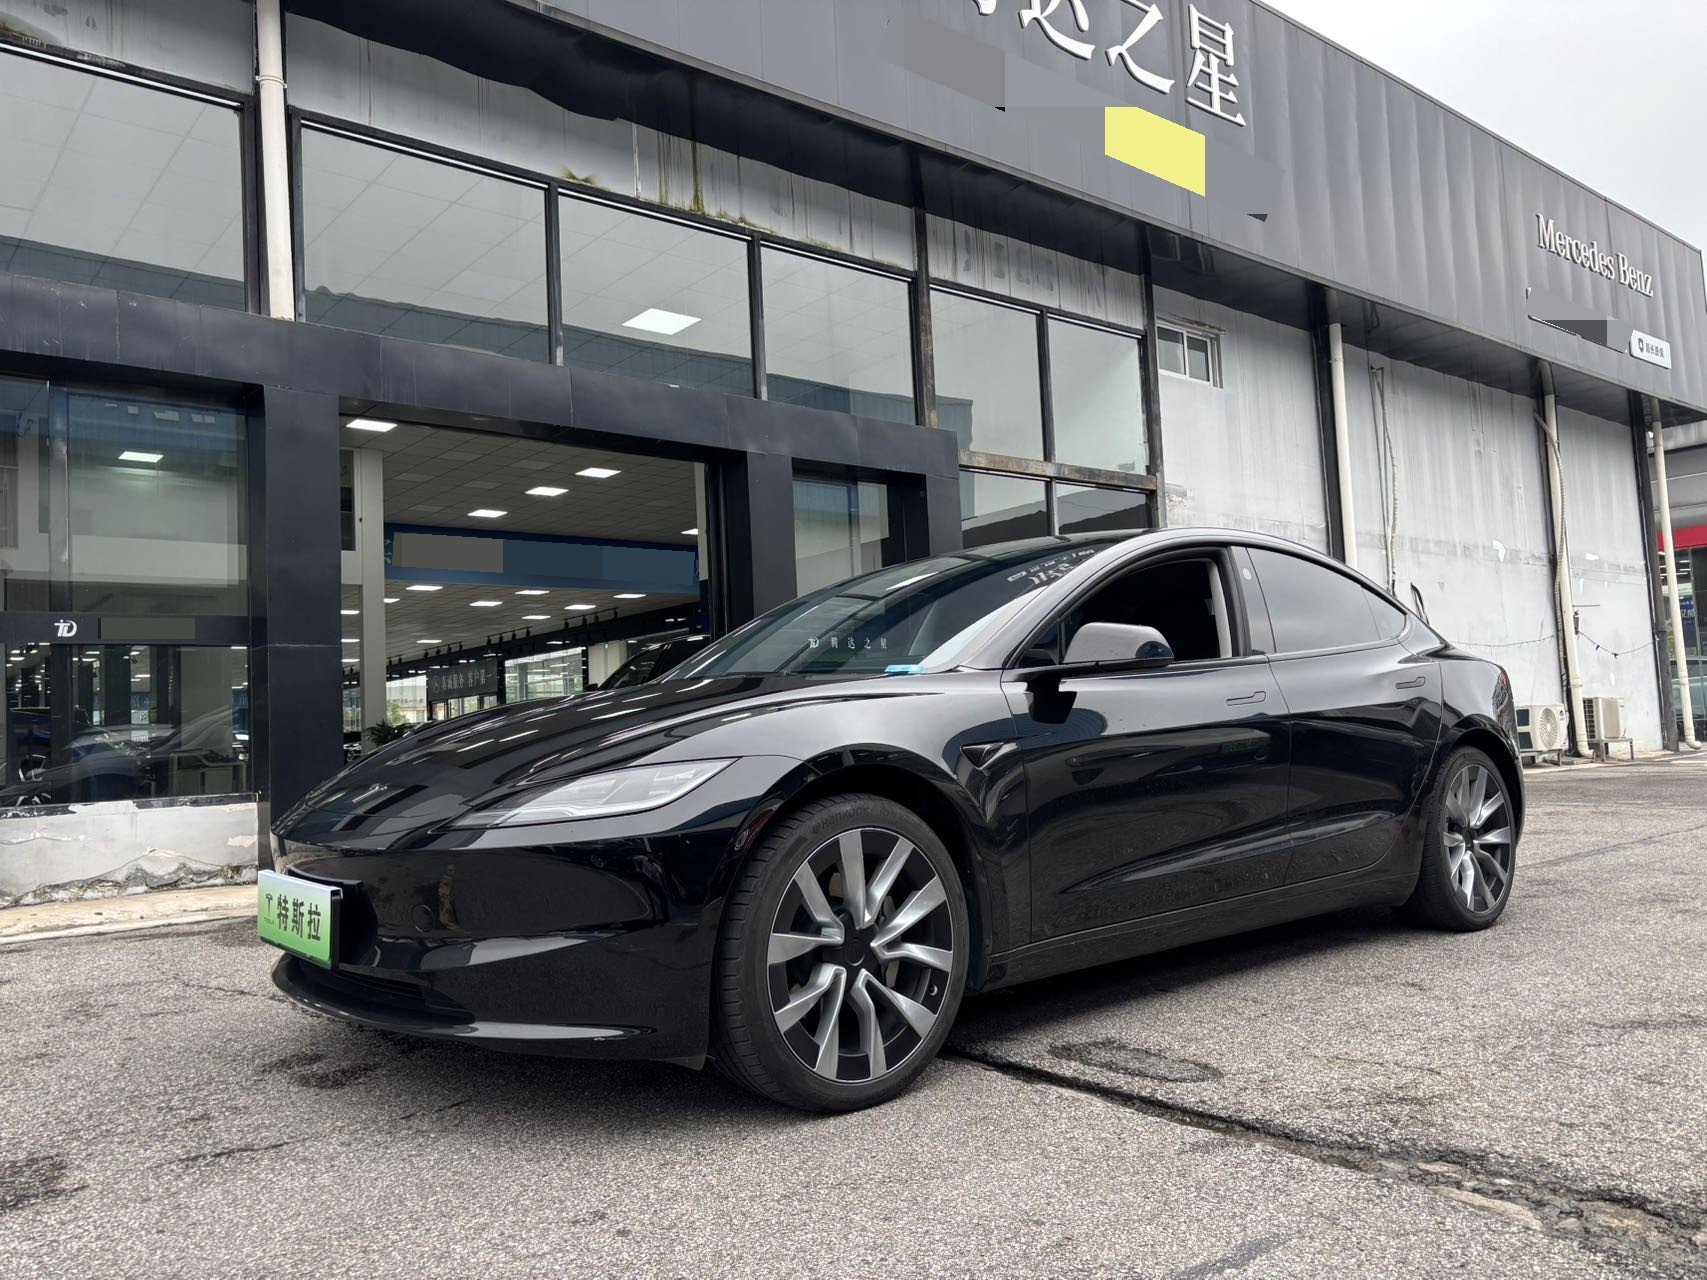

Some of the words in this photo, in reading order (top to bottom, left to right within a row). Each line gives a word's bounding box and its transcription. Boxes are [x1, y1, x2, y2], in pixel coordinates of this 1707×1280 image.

[1536, 213, 1615, 280] Mercedes
[1616, 252, 1654, 297] Benz
[277, 893, 321, 942] 特斯拉
